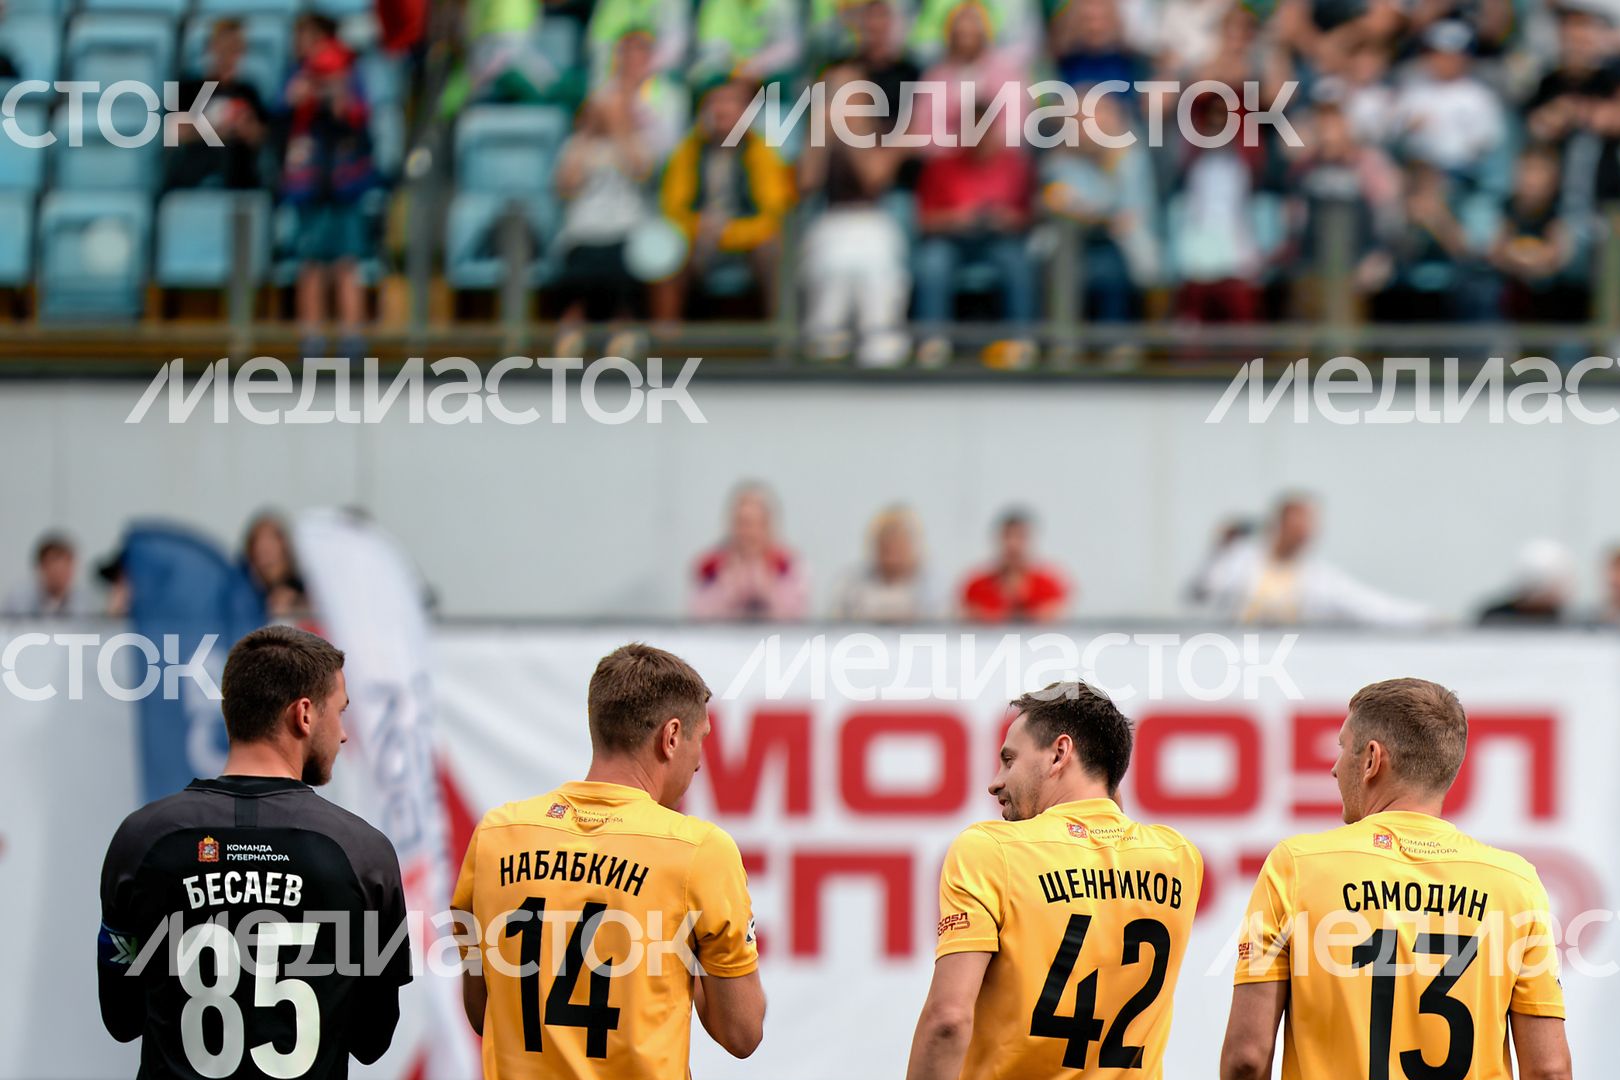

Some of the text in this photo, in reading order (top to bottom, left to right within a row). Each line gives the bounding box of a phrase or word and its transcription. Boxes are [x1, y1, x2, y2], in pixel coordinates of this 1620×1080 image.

[226, 844, 273, 853] КОМАНДА
[226, 853, 290, 862] ГУБЕРНАТОРА
[183, 870, 304, 910] БЕСАЕВ
[500, 850, 650, 897] НАБАБКИН
[1038, 868, 1182, 910] ЩЕННИКОВ
[1342, 880, 1488, 922] САМОДИН
[505, 896, 621, 1059] 14
[1030, 914, 1171, 1070] 42
[177, 921, 321, 1080] 85
